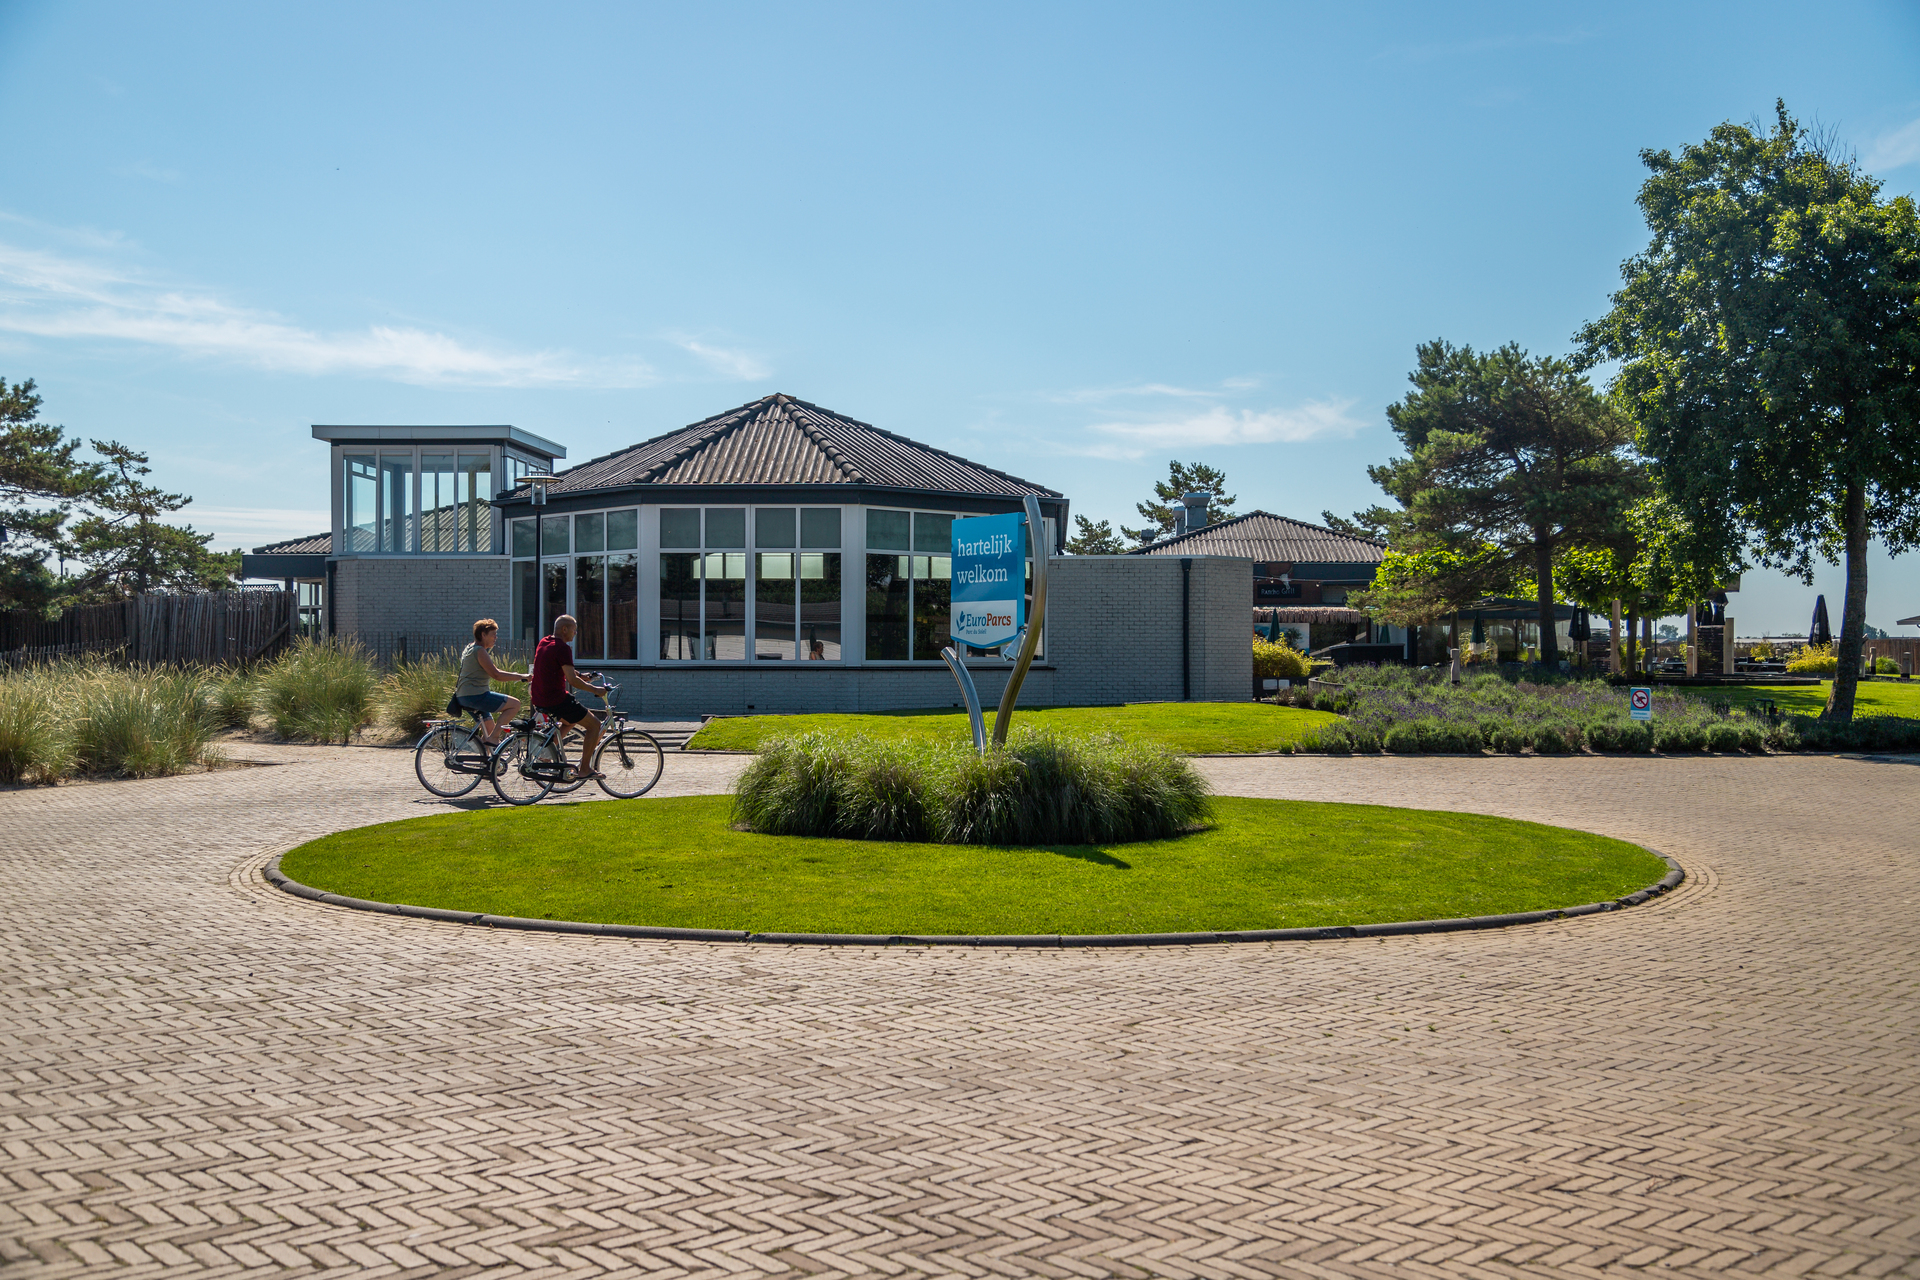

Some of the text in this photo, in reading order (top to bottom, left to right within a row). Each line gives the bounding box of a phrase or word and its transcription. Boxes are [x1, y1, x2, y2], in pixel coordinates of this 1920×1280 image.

[957, 534, 1012, 560] hartelijk
[957, 564, 1008, 584] welkom
[966, 613, 1012, 627] EuroParcs
